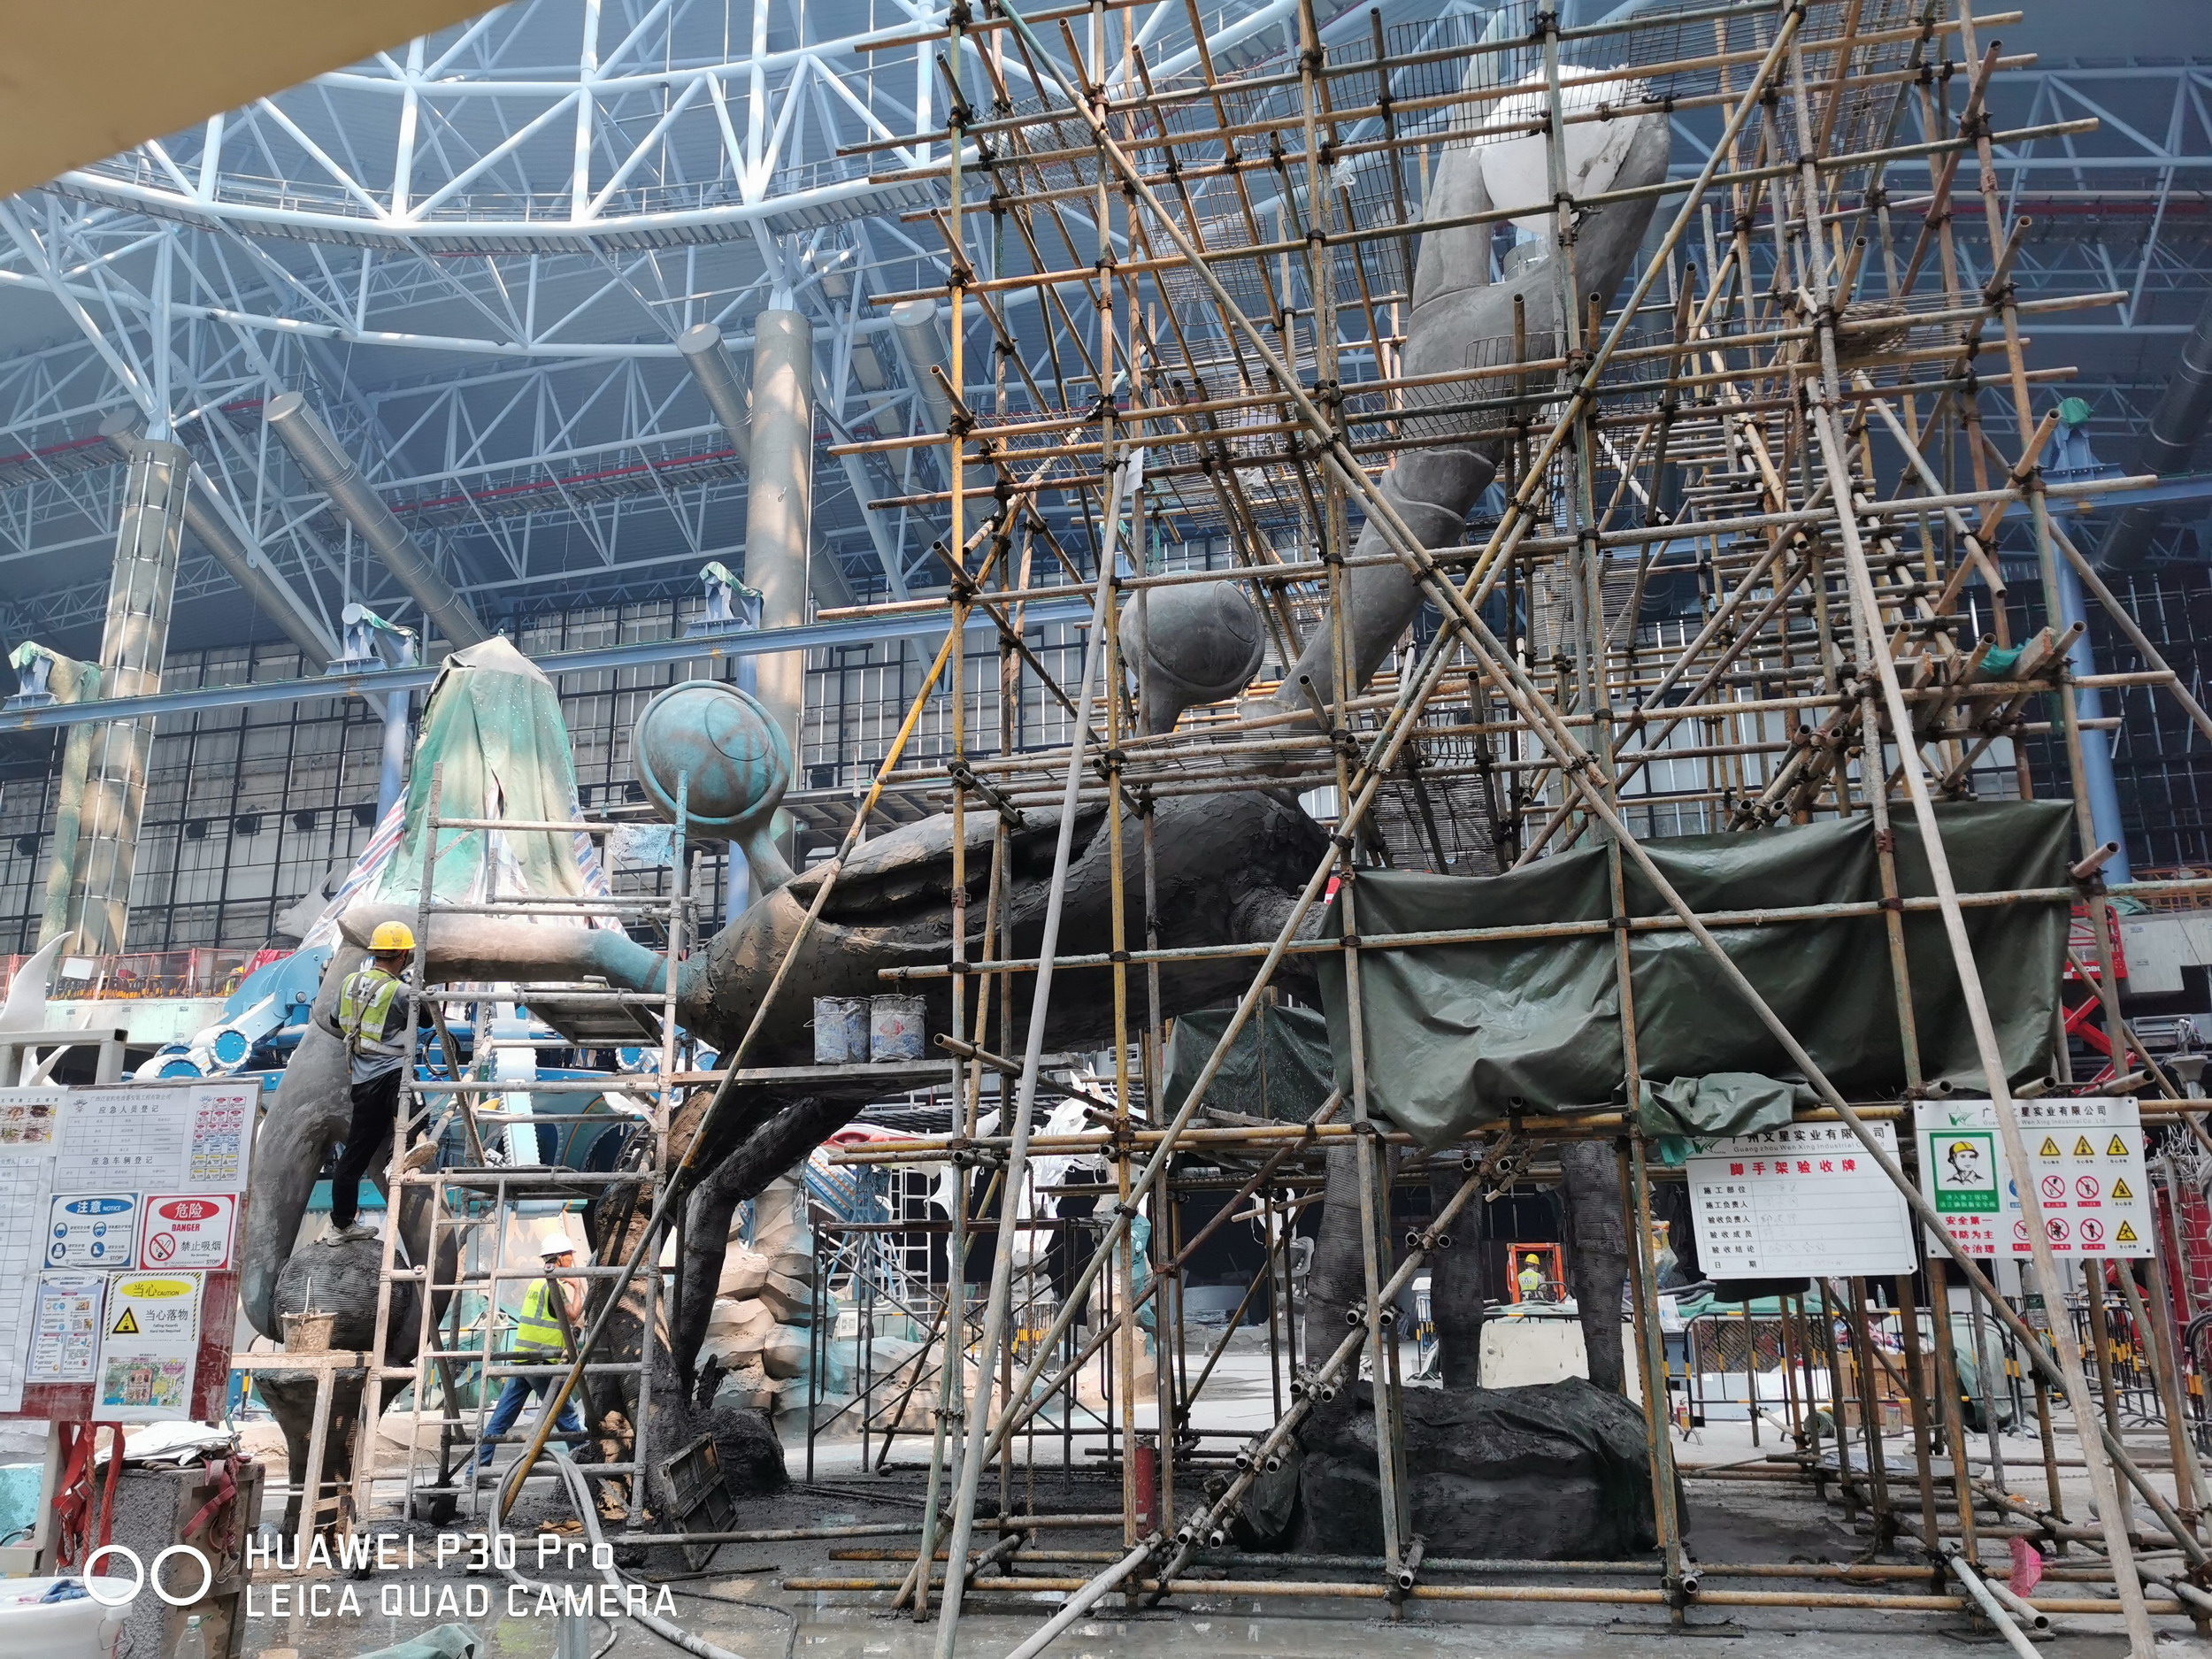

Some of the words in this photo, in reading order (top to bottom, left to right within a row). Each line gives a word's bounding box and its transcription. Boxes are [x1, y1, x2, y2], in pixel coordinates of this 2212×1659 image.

[98, 1104, 159, 1115] 应急人员登记
[1982, 1105, 2107, 1118] 广星实业有限公司
[1732, 1126, 1885, 1145] 州文星实业有限司
[1798, 1142, 1816, 1151] Xing
[1816, 1140, 1855, 1149] Industrial
[91, 1156, 153, 1166] 应急车辆登记
[1729, 1159, 1857, 1176] 脚手架验收牌
[1703, 1185, 1747, 1194] 施工部位
[76, 1200, 101, 1214] 注意
[1705, 1200, 1748, 1210] 施工负责人
[173, 1202, 204, 1219] 危险
[1708, 1215, 1750, 1225] 验收负责人
[1946, 1216, 1993, 1225] 安全第一
[171, 1223, 200, 1232] DANGER
[1709, 1230, 1752, 1239] 验收成员
[180, 1240, 222, 1252] 禁止吸烟
[1711, 1245, 1755, 1254] 验收结论
[1961, 1244, 1996, 1254] 合治理
[1714, 1260, 1757, 1269] 日期
[132, 1283, 157, 1298] 当心
[144, 1308, 188, 1321] 当心落物
